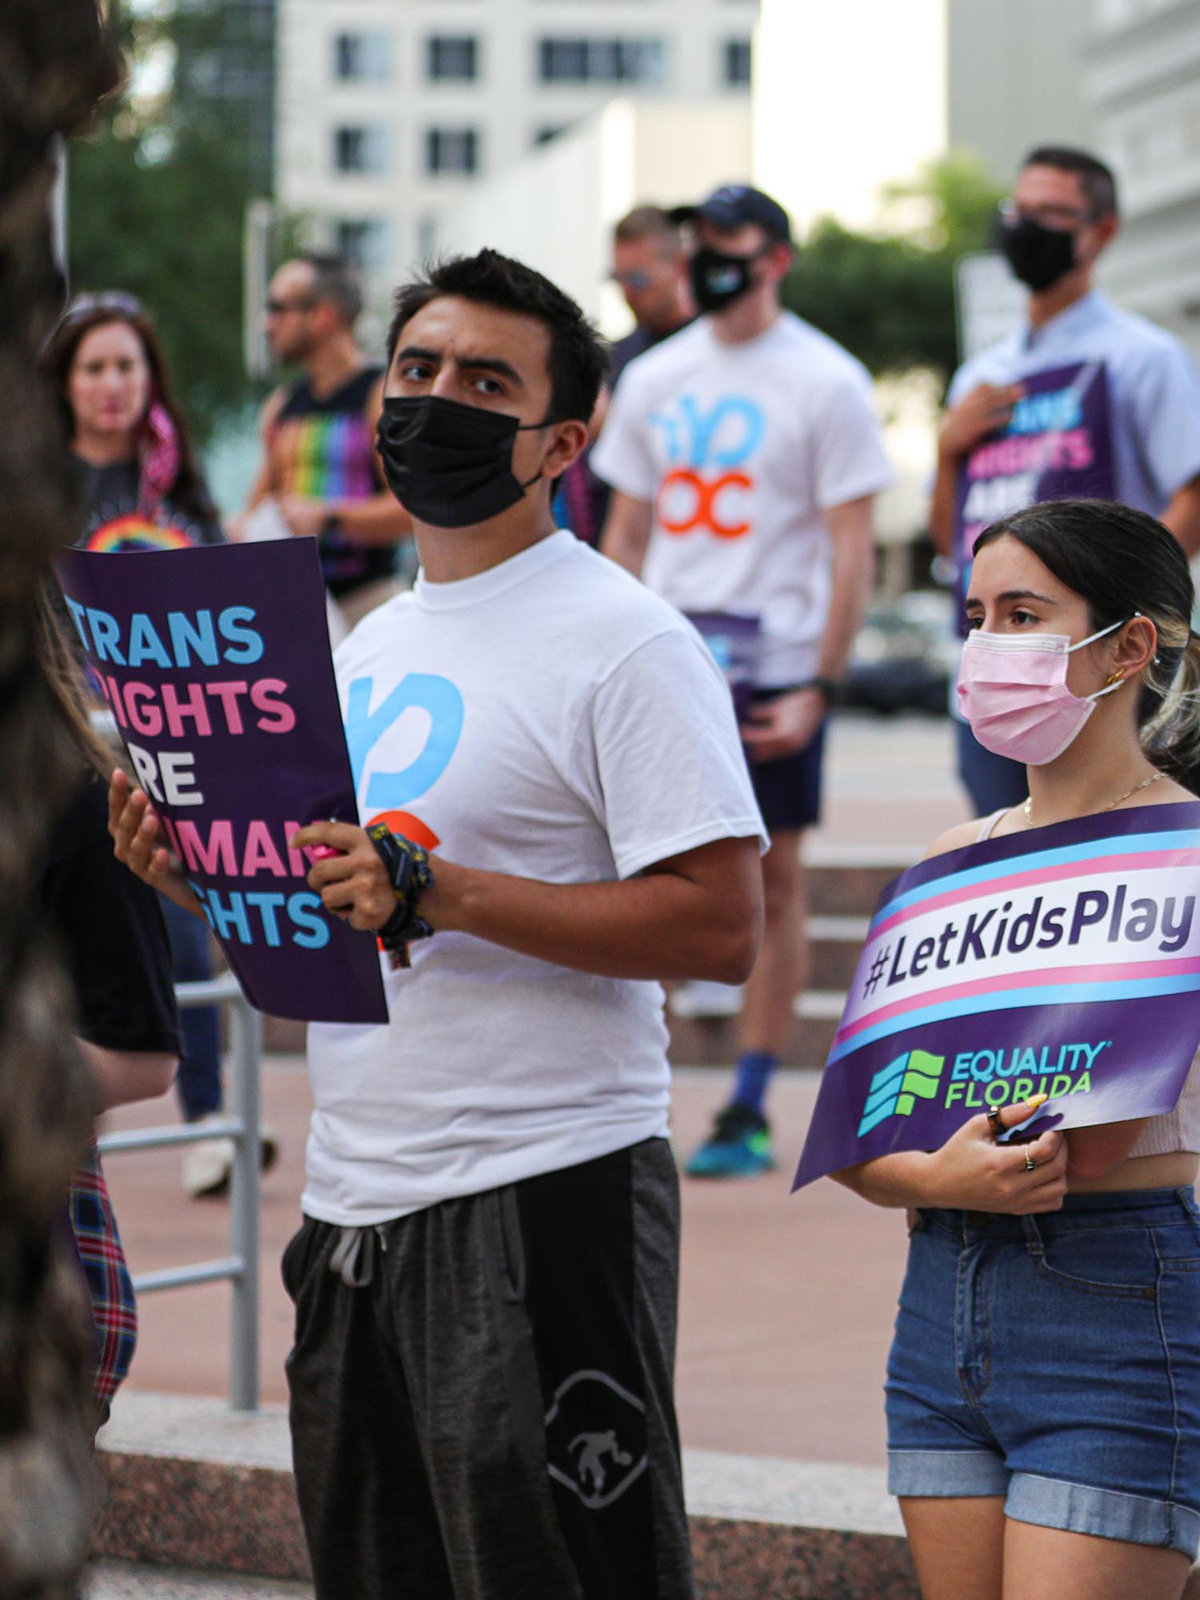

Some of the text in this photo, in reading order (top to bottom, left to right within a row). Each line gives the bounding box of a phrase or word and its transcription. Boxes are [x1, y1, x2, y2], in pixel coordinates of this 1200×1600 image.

[127, 741, 205, 806] RE
[862, 884, 1196, 999] #LetKidsPlay
[951, 1041, 1107, 1083] EQUALITY
[944, 1071, 1091, 1109] FLORIDA
